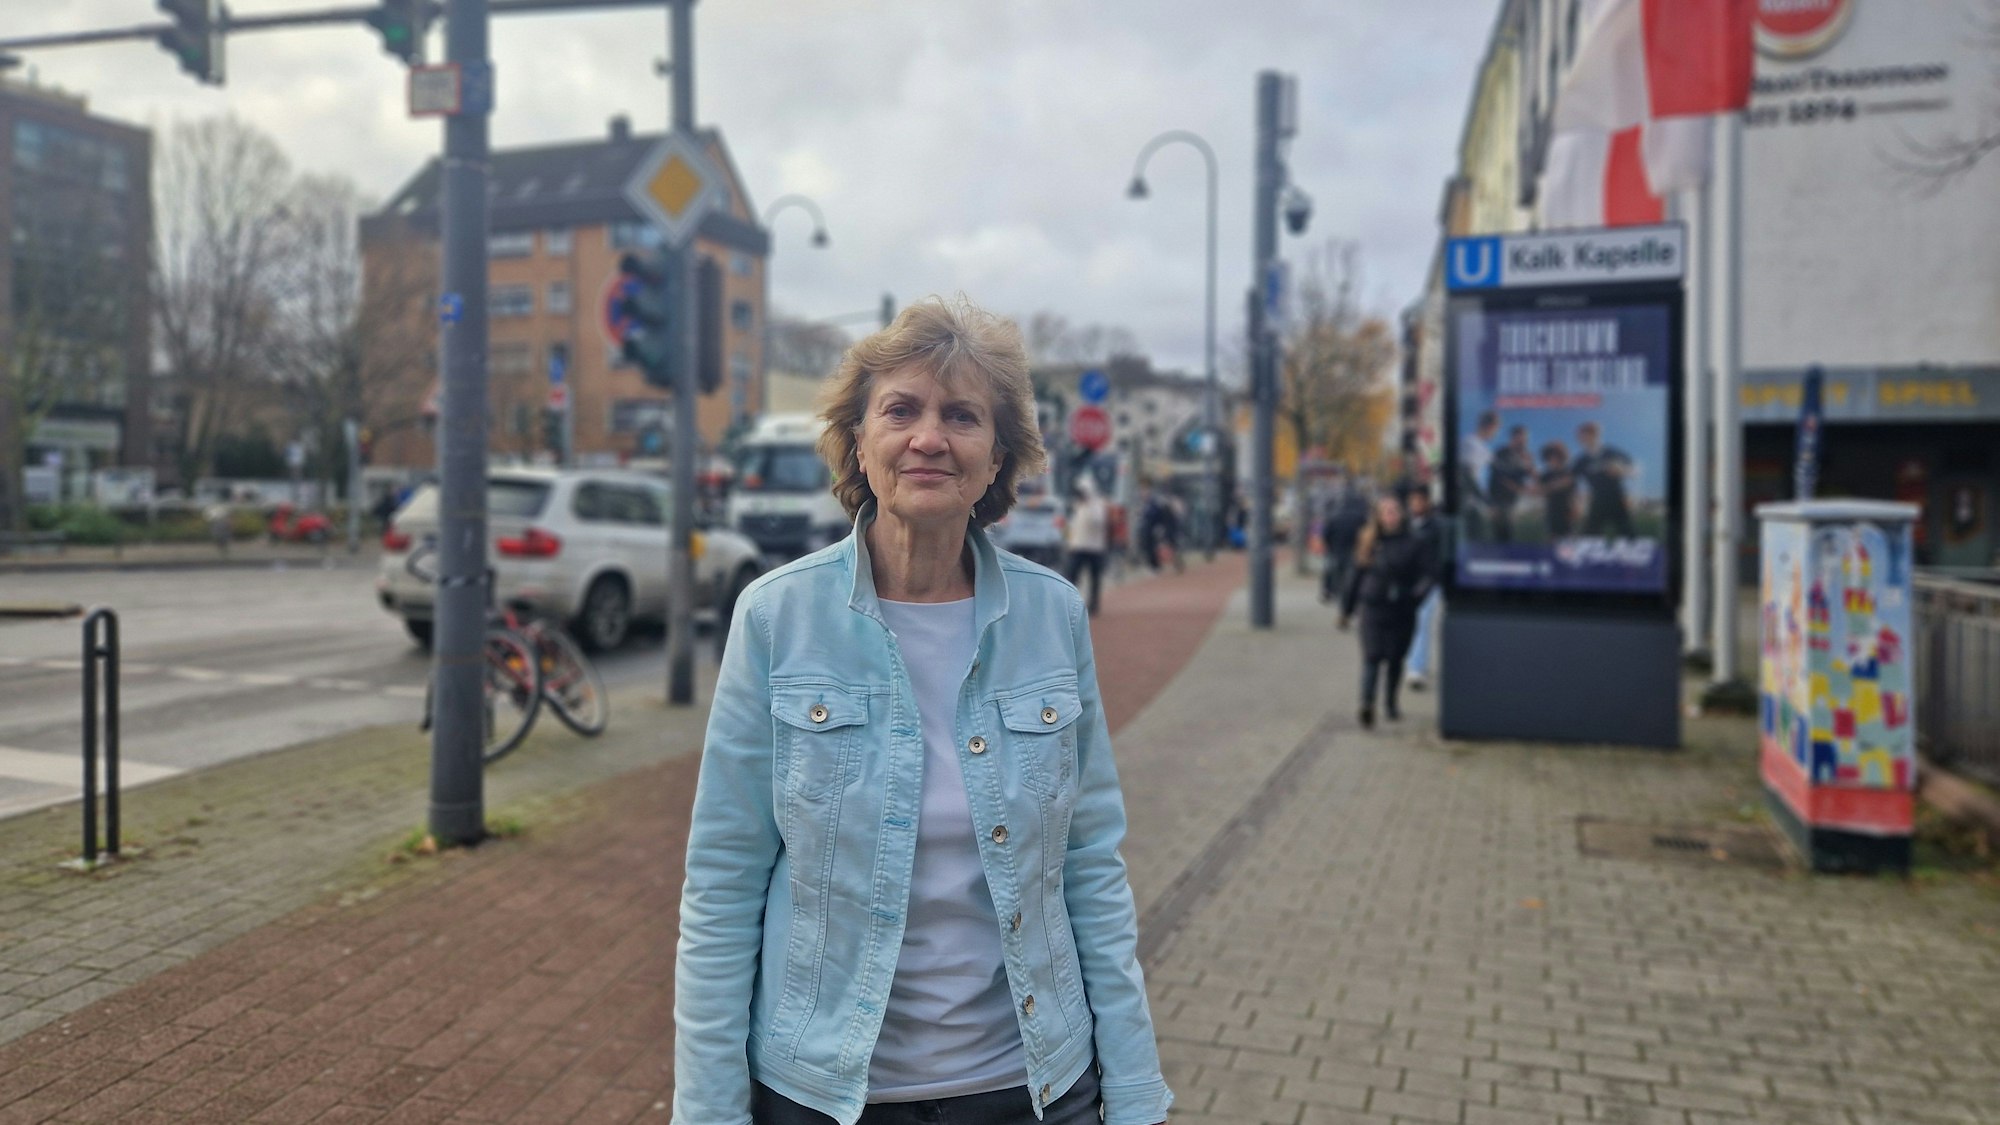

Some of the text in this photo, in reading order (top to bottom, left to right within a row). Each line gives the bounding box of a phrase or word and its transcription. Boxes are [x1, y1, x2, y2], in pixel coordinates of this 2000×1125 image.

[1455, 237, 1675, 284] U Kalk Kapelle
